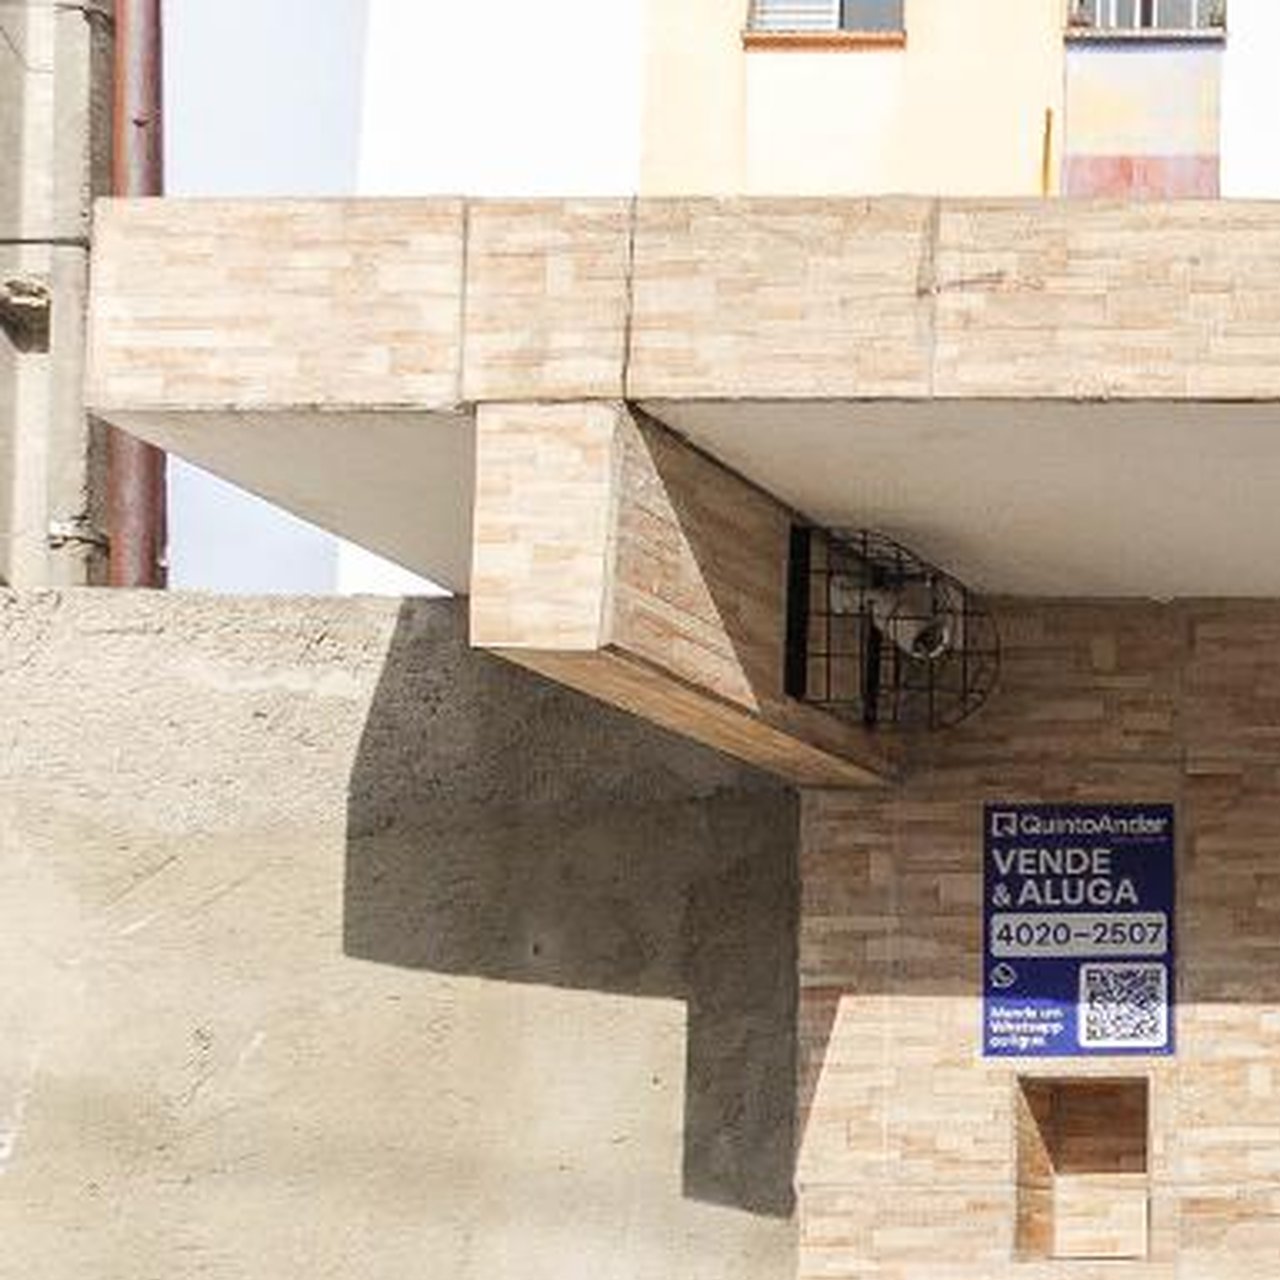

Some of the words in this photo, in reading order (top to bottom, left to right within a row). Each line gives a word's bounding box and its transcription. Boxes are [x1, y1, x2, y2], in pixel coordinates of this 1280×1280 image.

[1020, 814, 1168, 834] QuintoAndar
[992, 849, 1111, 875] VENDE
[992, 883, 1011, 906] &
[1018, 879, 1138, 905] ALUGA
[997, 922, 1163, 944] 4020-2507
